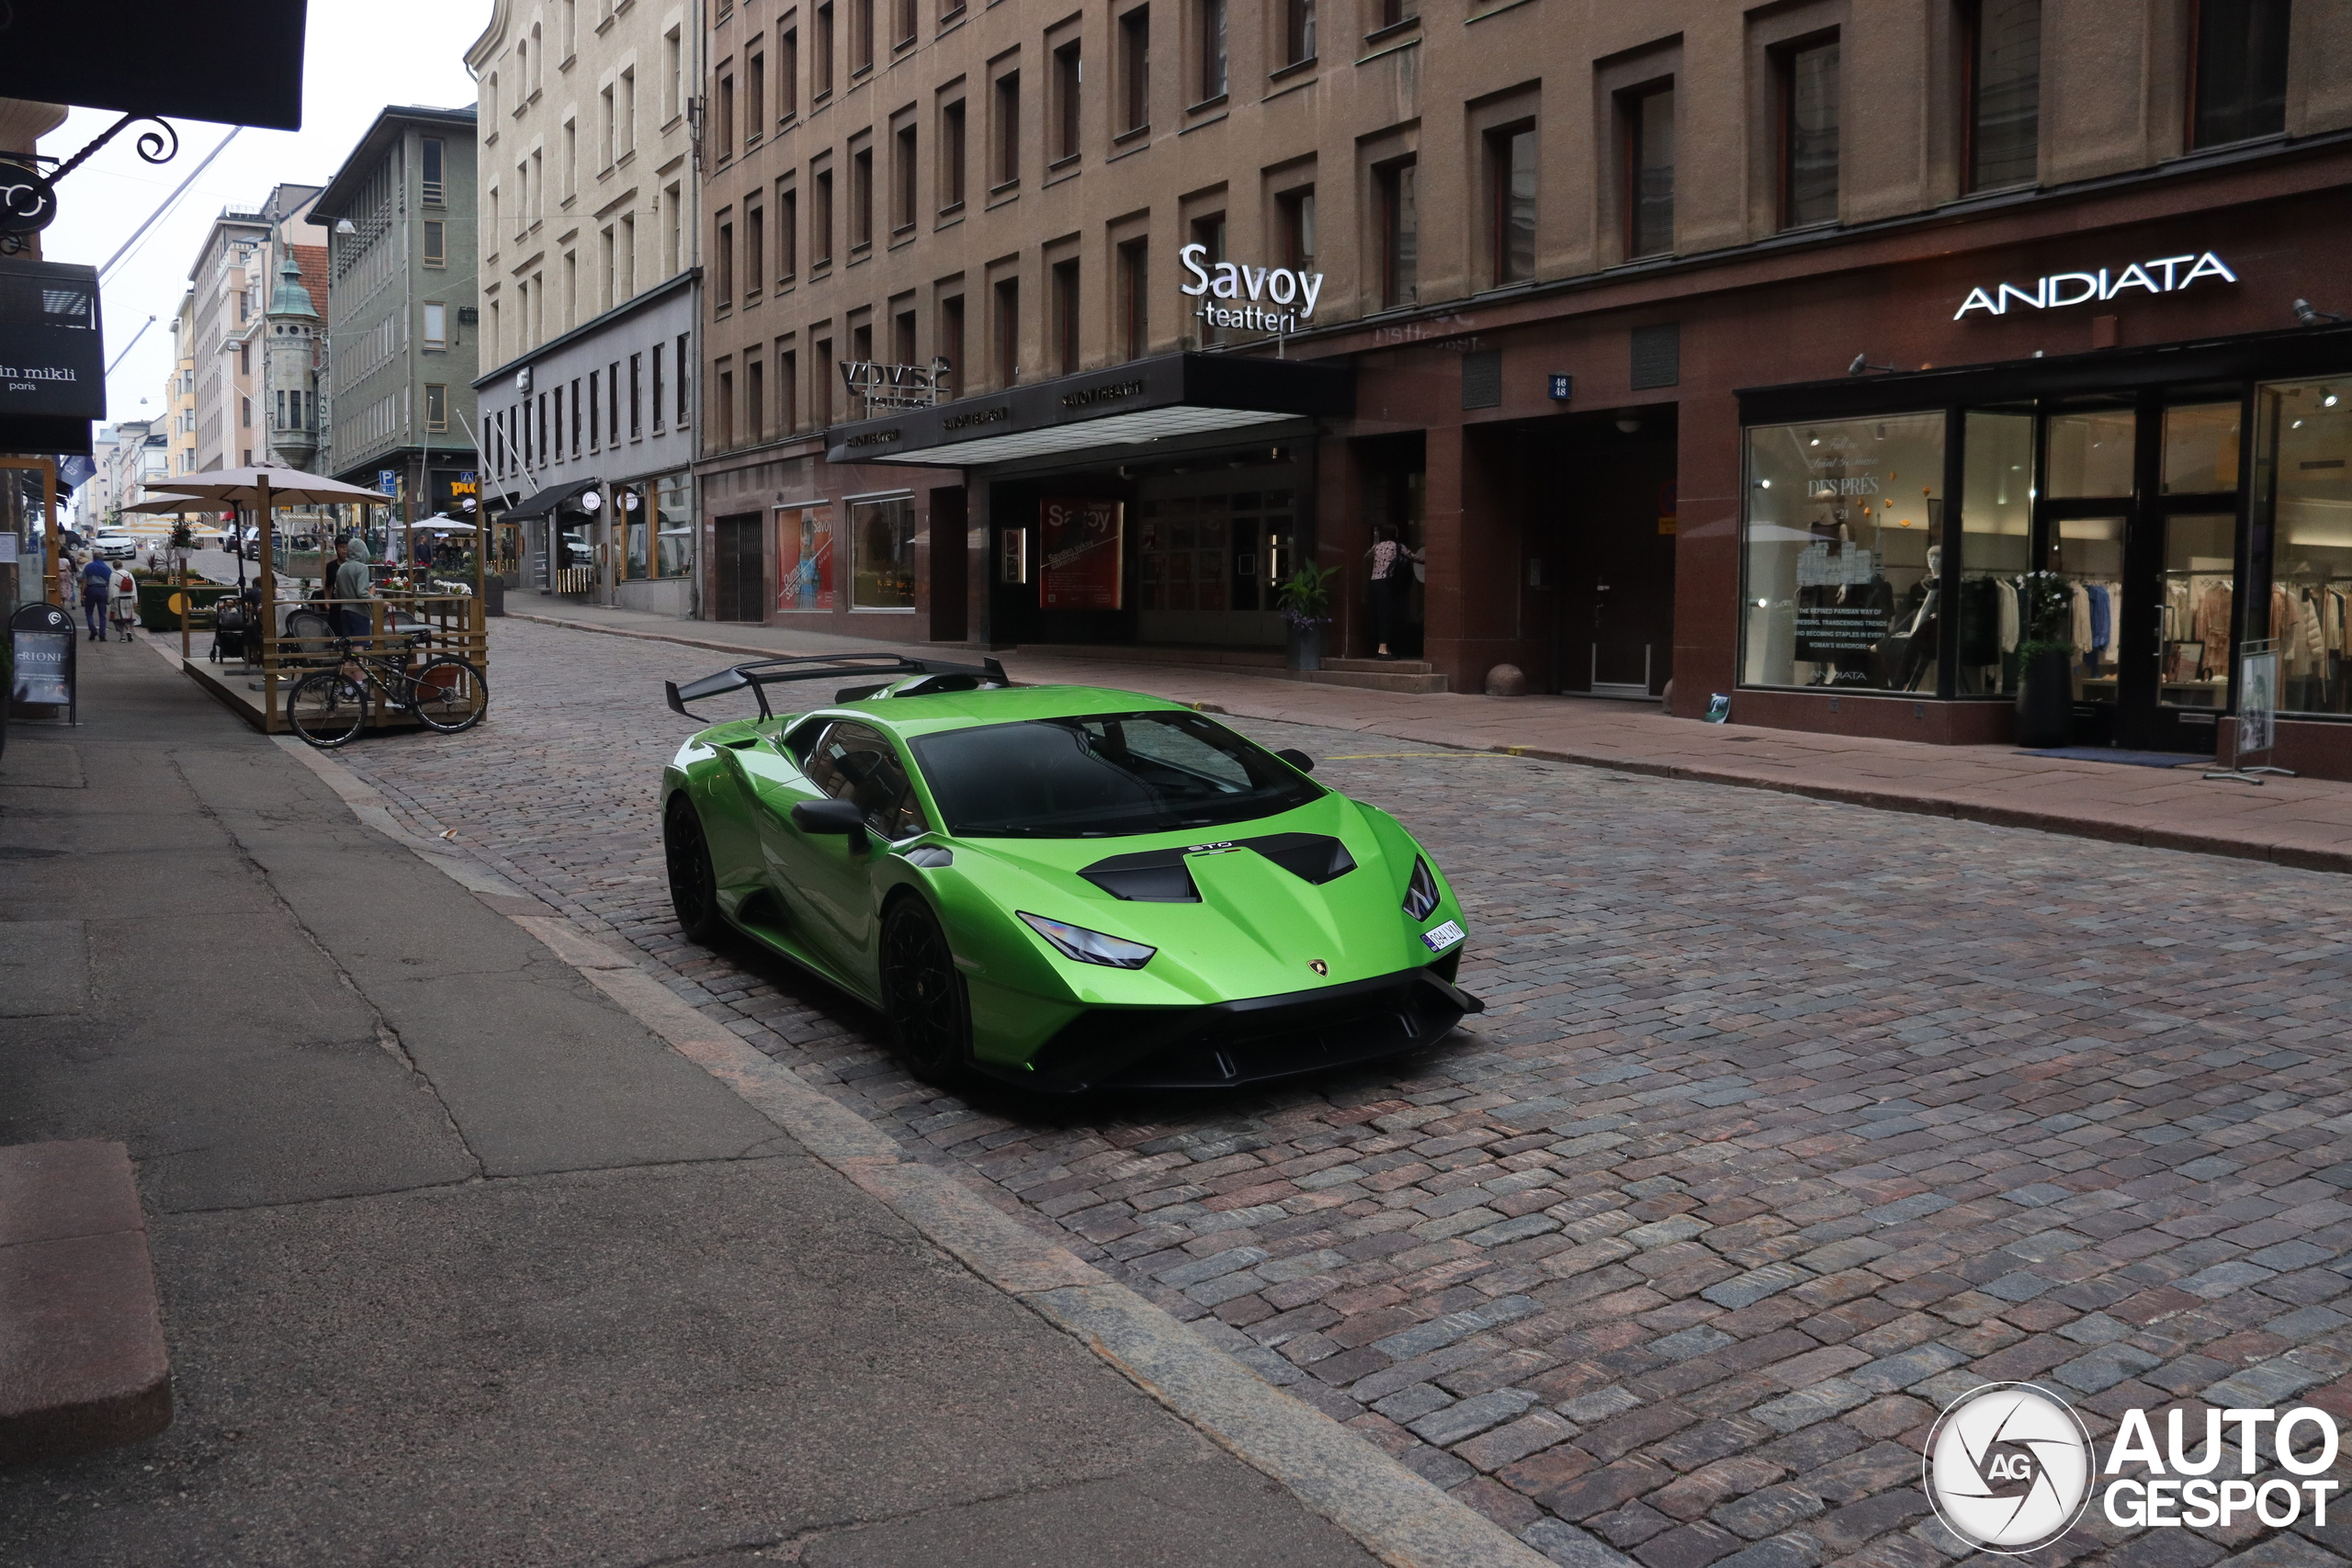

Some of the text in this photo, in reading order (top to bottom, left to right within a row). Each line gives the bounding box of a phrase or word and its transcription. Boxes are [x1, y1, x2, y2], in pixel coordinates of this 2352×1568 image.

[1179, 243, 1323, 319] Savoy
[1952, 250, 2238, 321] ANDIATA
[8, 381, 36, 391] paris
[23, 367, 76, 381] mikli
[1062, 378, 1140, 407] SAVOY THEATRE
[1808, 472, 1880, 498] DES PRÉS
[17, 651, 62, 661] RIONI
[1430, 922, 1464, 946] 094 LYM
